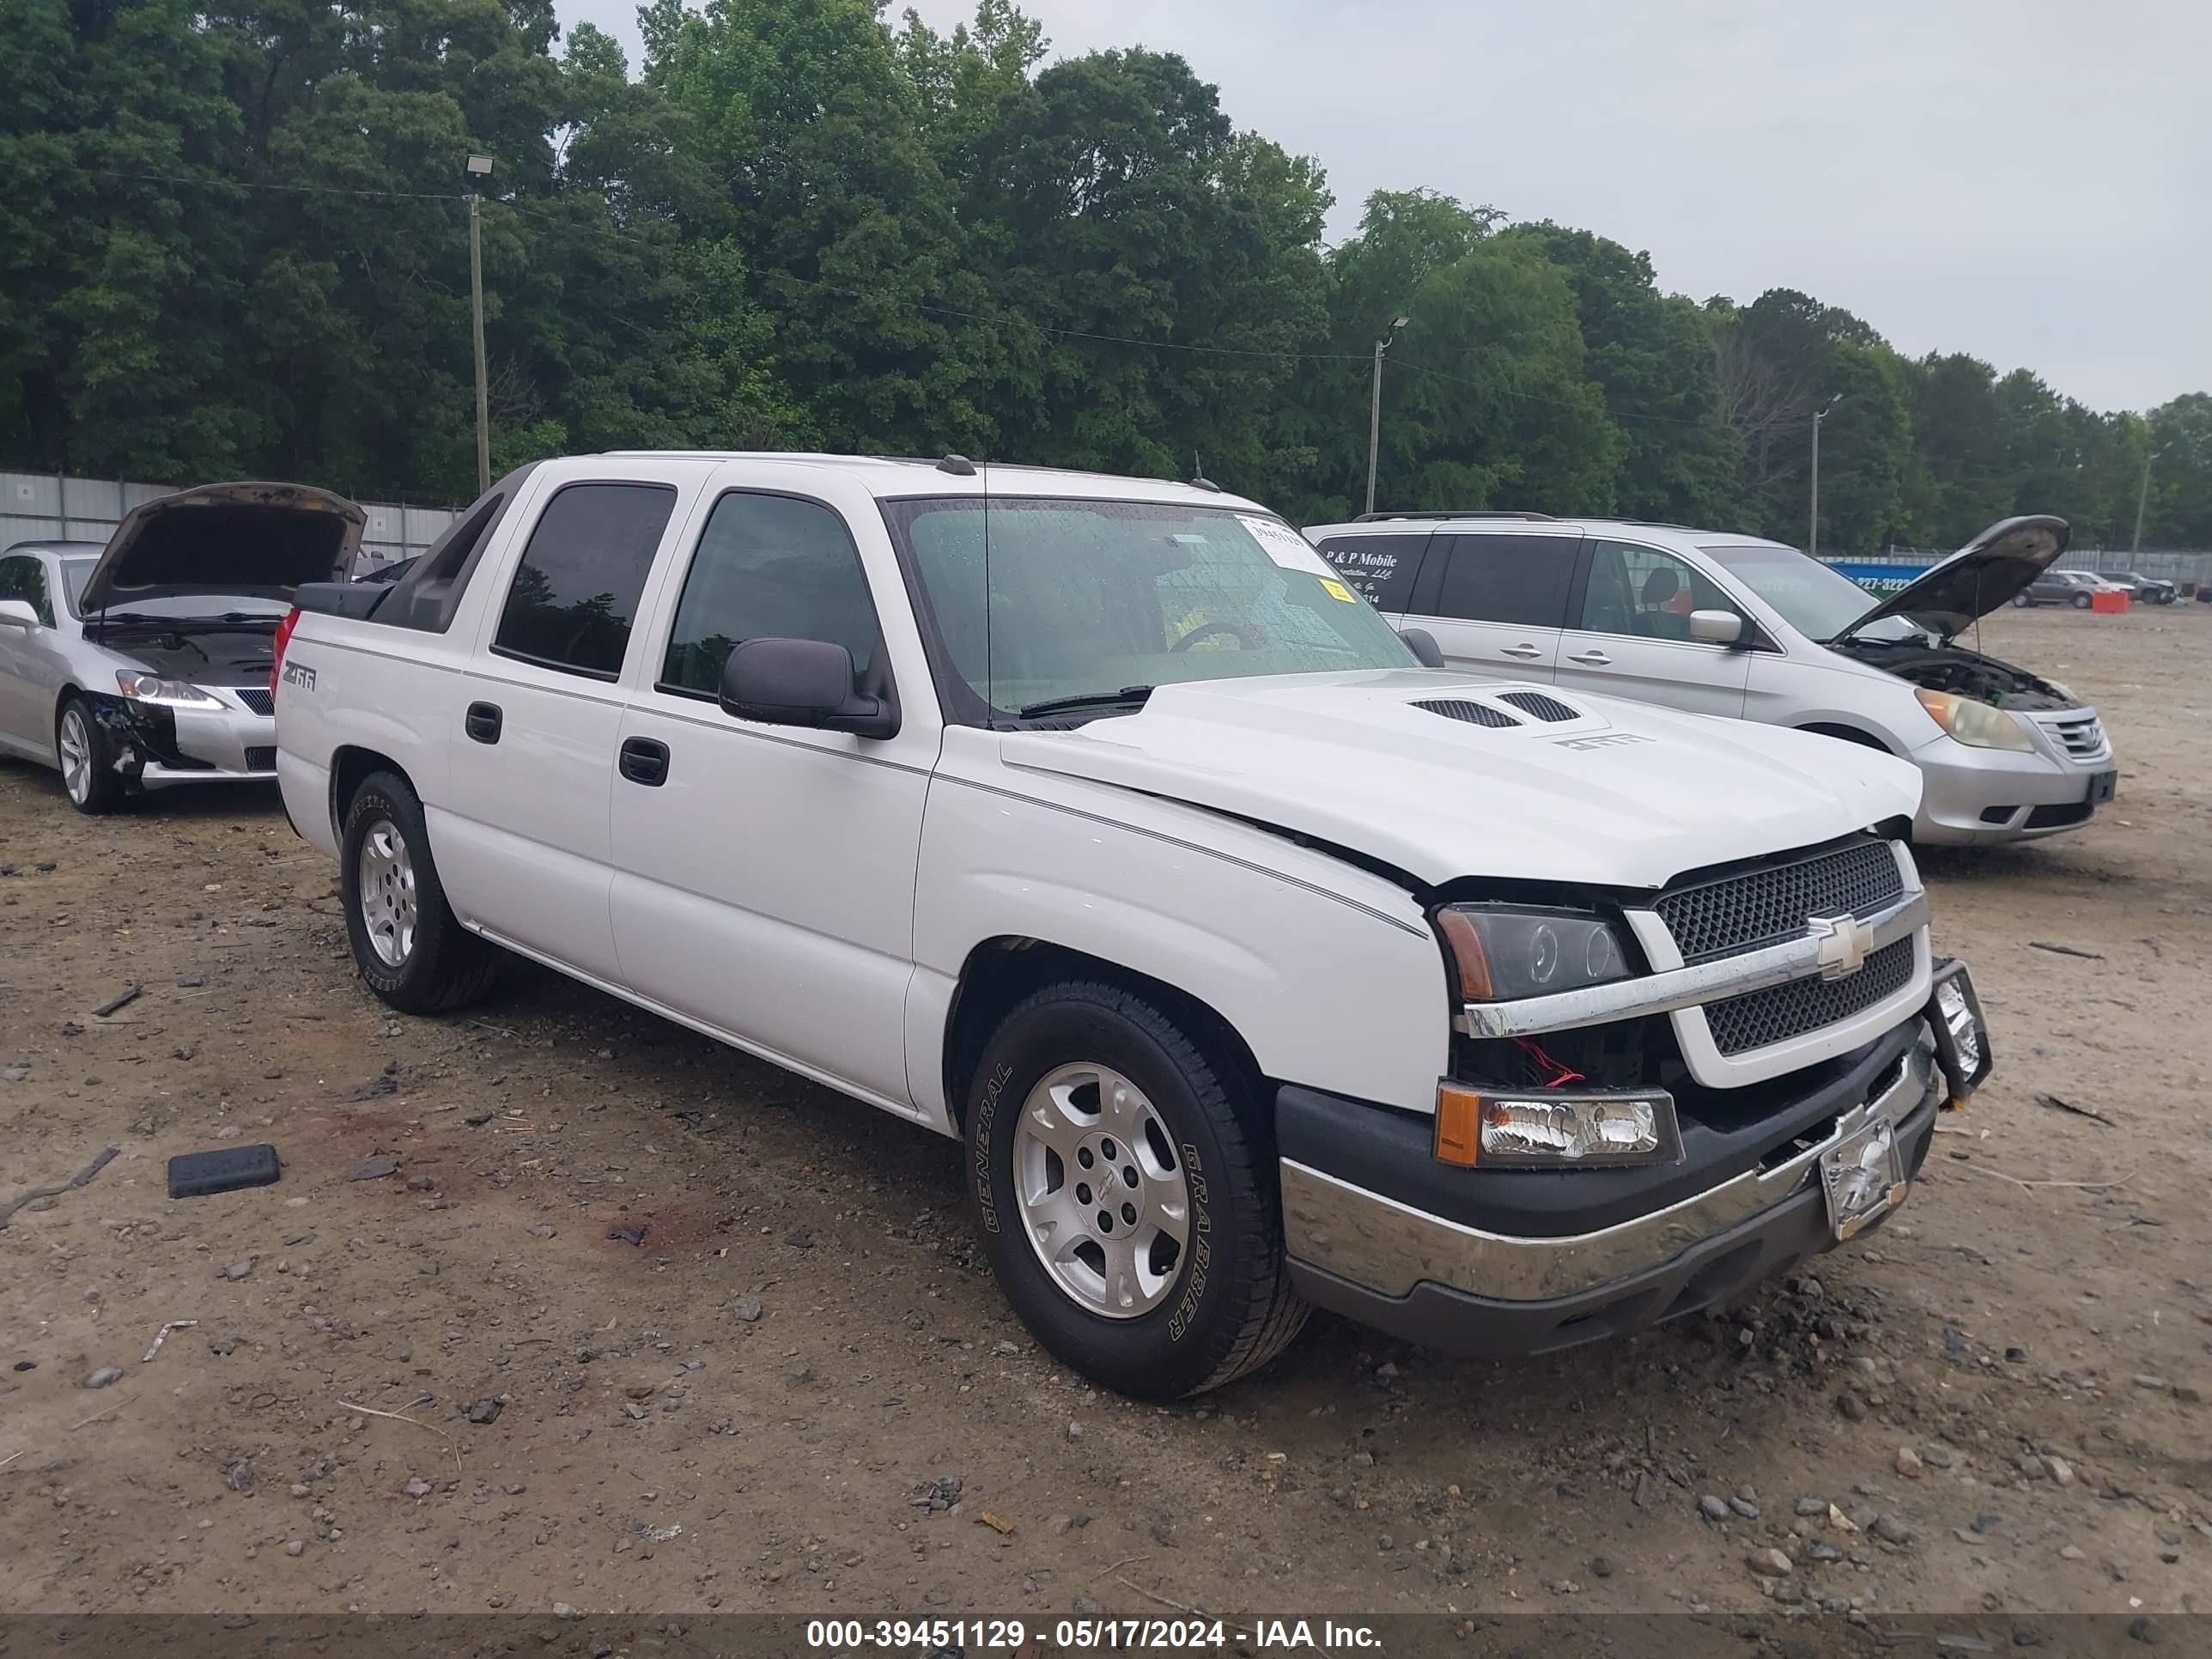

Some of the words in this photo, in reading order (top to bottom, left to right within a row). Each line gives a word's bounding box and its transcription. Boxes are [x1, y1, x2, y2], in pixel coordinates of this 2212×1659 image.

[1334, 551, 1346, 564] &
[1347, 552, 1358, 564] P
[1357, 553, 1397, 568] Mobile
[975, 1063, 1014, 1234] GENERAL
[1167, 1142, 1211, 1342] GRABBER
